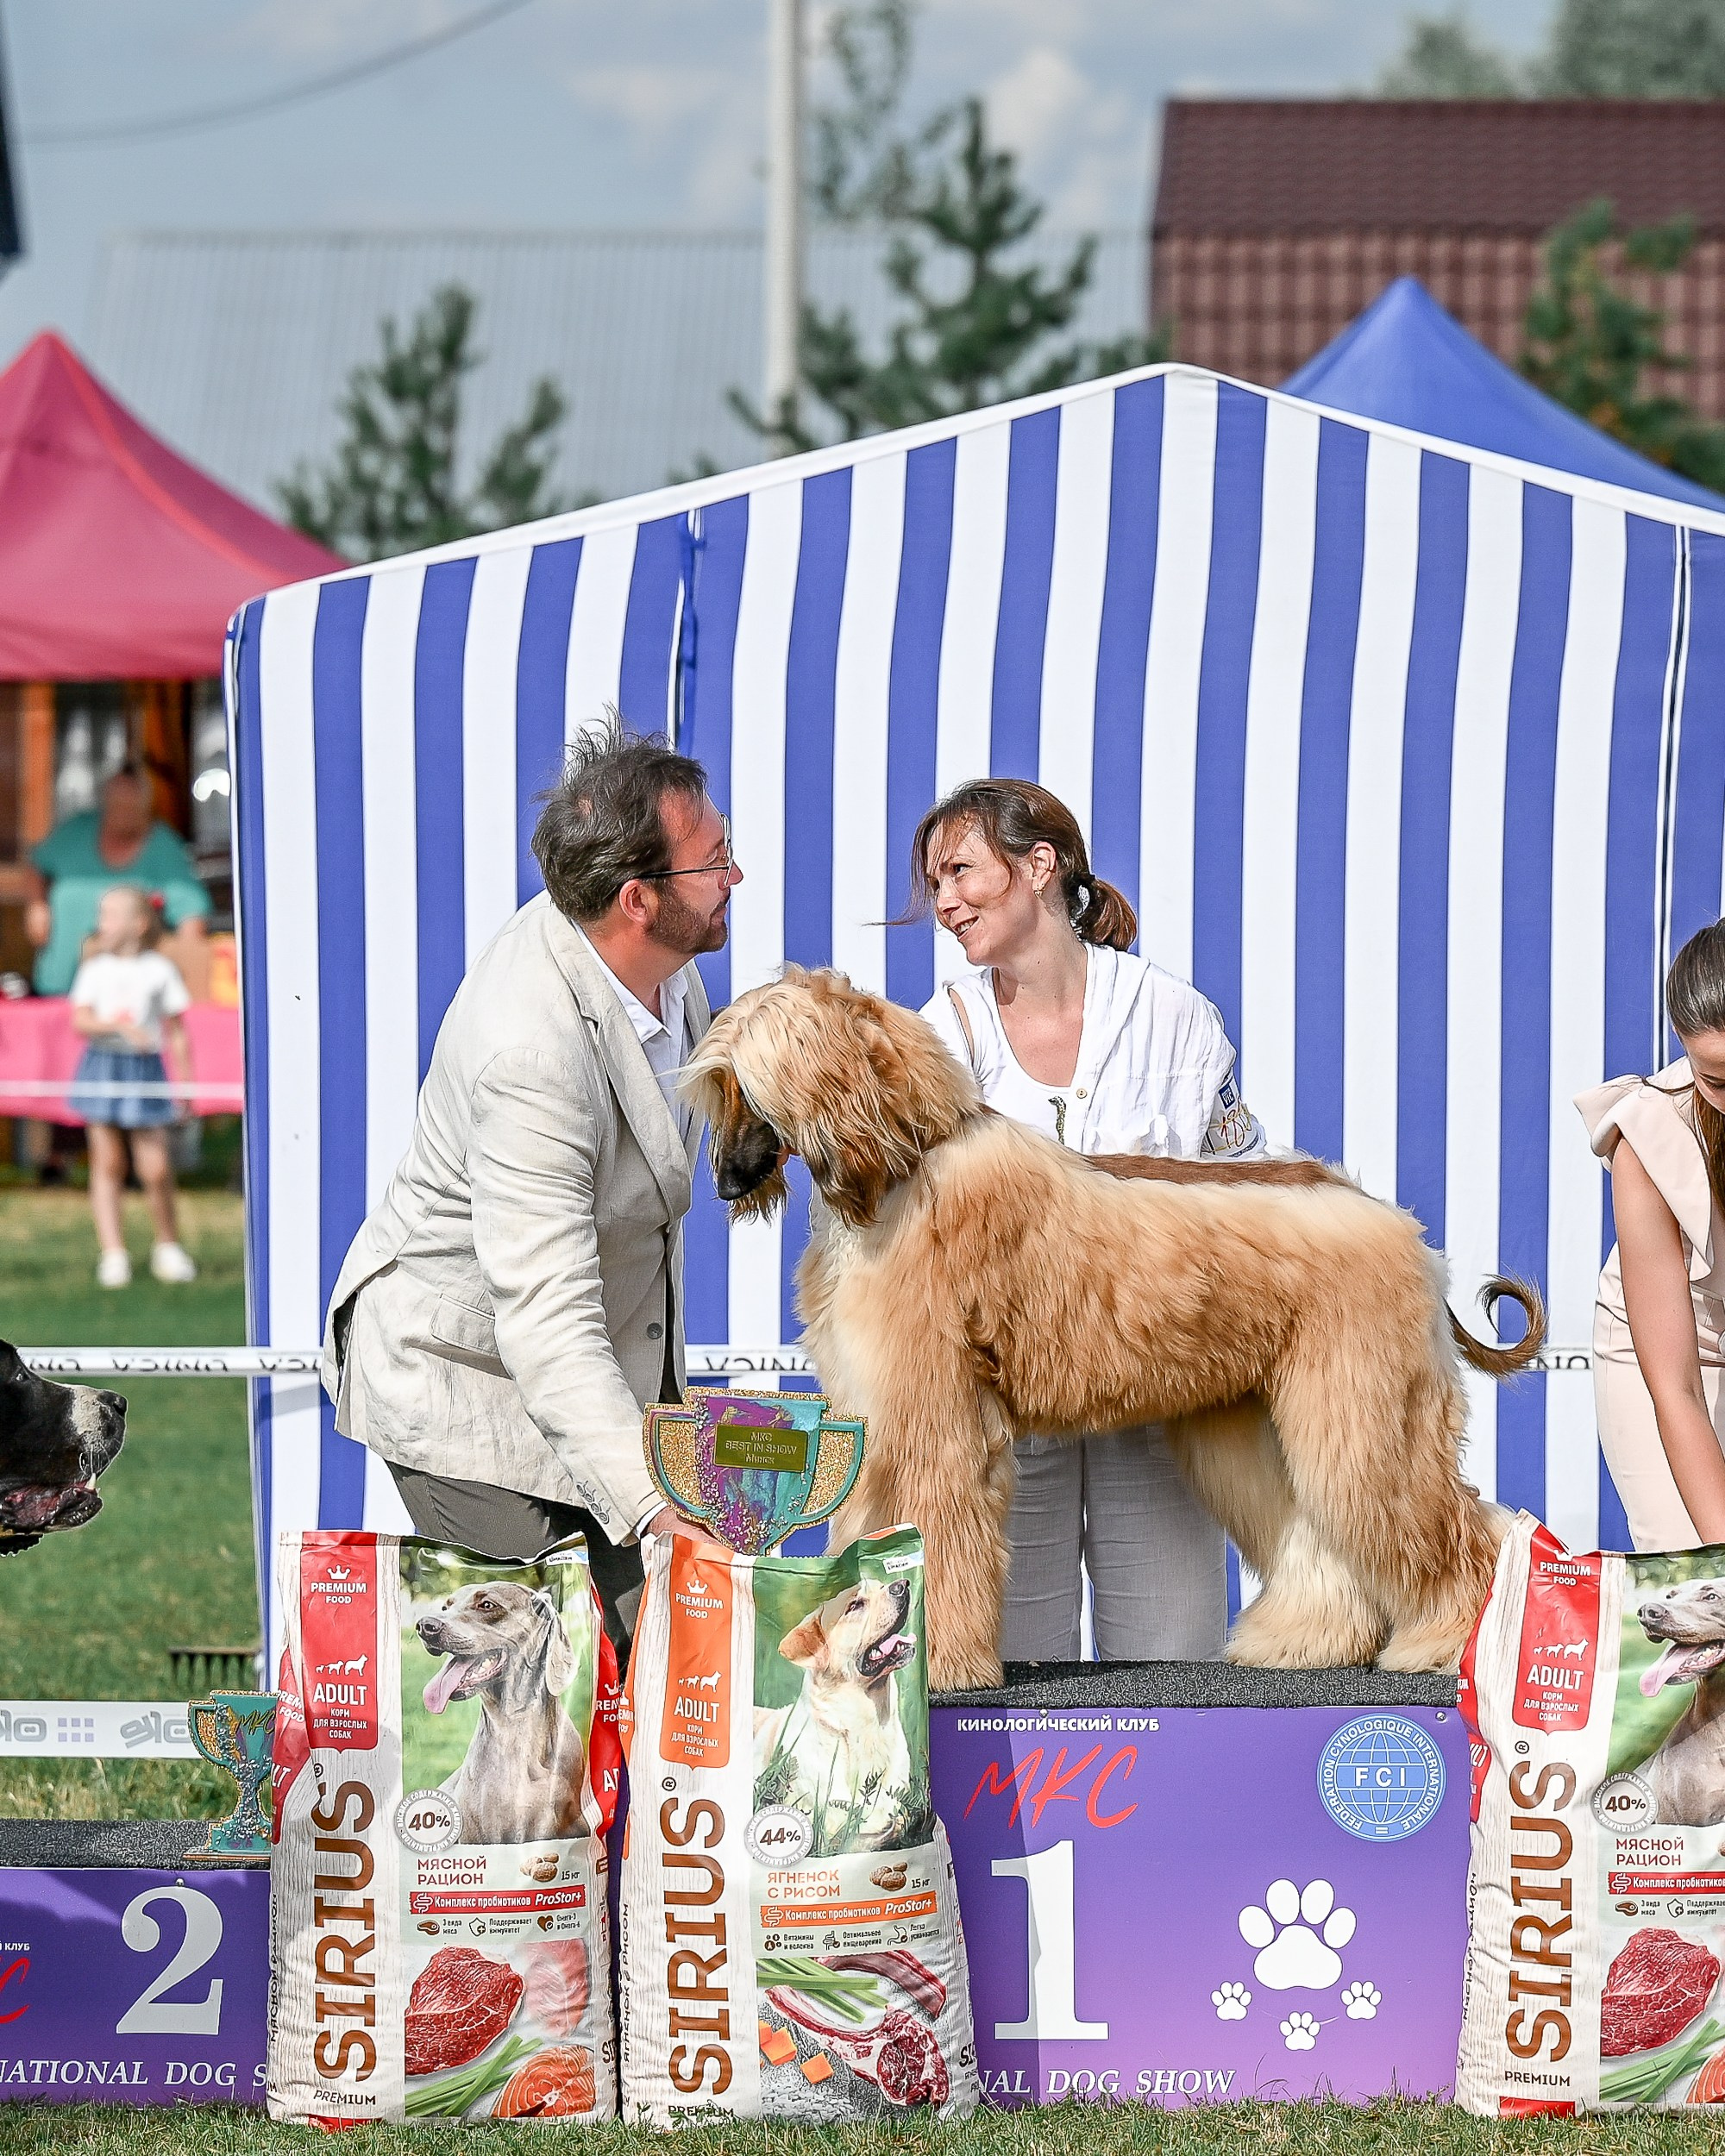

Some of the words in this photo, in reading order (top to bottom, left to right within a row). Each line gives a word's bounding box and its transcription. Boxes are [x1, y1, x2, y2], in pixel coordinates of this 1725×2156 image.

[725, 1440, 751, 1451] BEST
[753, 1444, 763, 1452] IN
[765, 1444, 797, 1455] SHOW
[1540, 1561, 1591, 1576] PREMIUM
[310, 1582, 367, 1594] PREMIUM
[1553, 1576, 1577, 1586] FOOD
[325, 1595, 352, 1604] FOOD
[675, 1593, 724, 1610] PREMIUM
[686, 1608, 708, 1619] FOOD
[1526, 1664, 1584, 1690] ADULT
[313, 1684, 368, 1706] ADULT
[674, 1695, 720, 1723] ADULT
[1524, 1699, 1540, 1710] ДЛЯ
[1540, 1701, 1579, 1712] ВЗРОСЛЫХ
[313, 1718, 327, 1730] ДЛЯ
[328, 1719, 367, 1730] ВЗРОСЛЫХ
[957, 1714, 1113, 1733] КИНОЛОГИЧЕСКИЙ
[1116, 1717, 1160, 1732] КЛУБ
[1539, 1711, 1562, 1721] СОБАК
[329, 1730, 352, 1739] СОБАК
[671, 1732, 685, 1743] ДЛЯ
[686, 1734, 719, 1748] ВЗРОСЛЫХ
[1329, 1719, 1414, 1758] CYNOLOGIQUE
[684, 1746, 704, 1758] СОБАК
[1402, 1733, 1440, 1831] INTERNATIONALE
[1323, 1759, 1364, 1831] FEDERATION
[1605, 1795, 1647, 1812] 40%
[408, 1811, 451, 1831] 40%
[759, 1827, 801, 1846] 44%
[1615, 1836, 1684, 1851] МЯСНОЙ
[417, 1855, 486, 1870] МЯСНОЙ
[1616, 1853, 1681, 1866] РАЦИОН
[417, 1873, 484, 1886] РАЦИОН
[561, 1871, 571, 1881] 15
[572, 1871, 580, 1881] кг
[768, 1869, 839, 1883] ЯГНЕНОК
[912, 1879, 920, 1889] 15
[921, 1877, 931, 1887] кг
[1633, 1877, 1675, 1888] Комплекс
[768, 1886, 779, 1899] С
[783, 1884, 841, 1899] РИСОМ
[434, 1895, 477, 1908] Комплекс
[478, 1894, 531, 1909] пробиотиков
[535, 1891, 582, 1907] ProStor+
[785, 1908, 826, 1921] Комплекс
[828, 1906, 881, 1921] пробиотиков
[885, 1898, 932, 1915] ProStor+
[1504, 1760, 1577, 2063] SIRIUS
[310, 1780, 377, 2083] SIRIUS
[660, 1797, 733, 2096] SIRIUS
[991, 1839, 1110, 2041] 1
[116, 1885, 224, 2036] 2
[164, 2061, 237, 2086] DOG
[1504, 2070, 1571, 2087] PREMIUM
[1045, 2070, 1121, 2095] DOG
[1135, 2070, 1236, 2095] SHOW
[313, 2090, 376, 2105] PREMIUM
